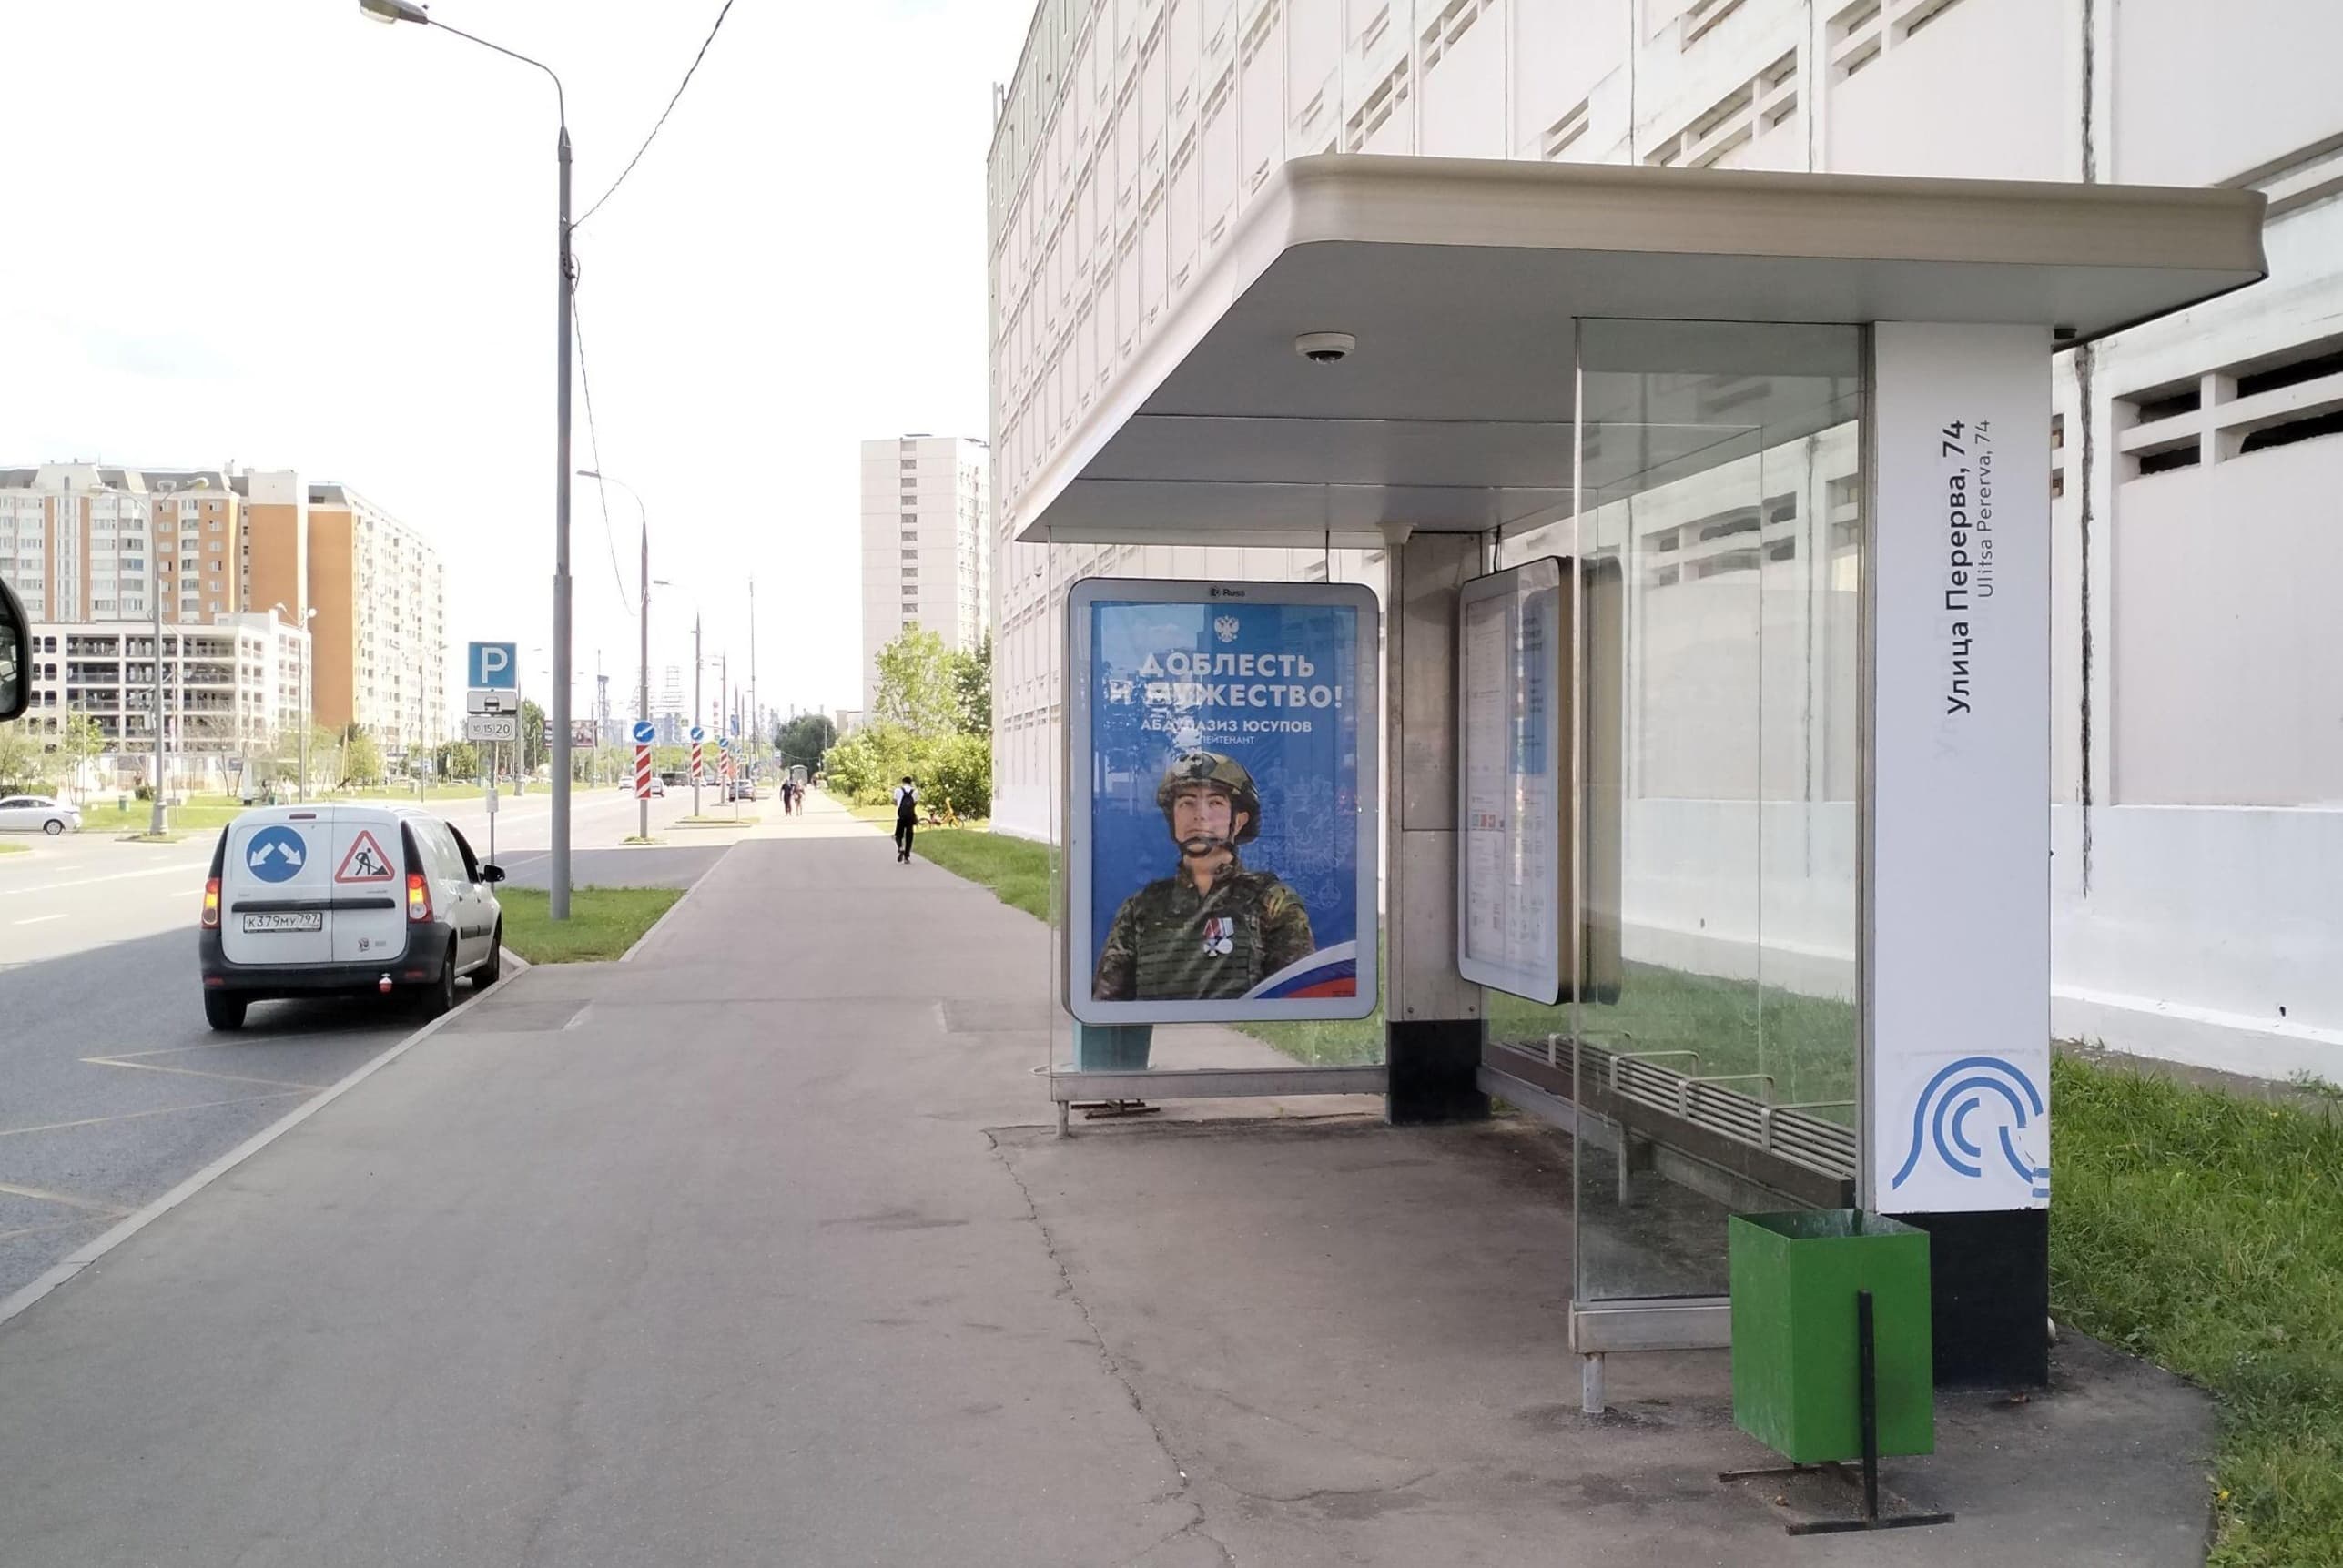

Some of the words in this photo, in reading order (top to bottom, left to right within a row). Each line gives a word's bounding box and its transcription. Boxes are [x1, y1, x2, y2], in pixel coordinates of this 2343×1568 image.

[1942, 420, 1966, 458] 74
[1974, 420, 1991, 445] 74
[1976, 450, 1994, 532] Pererva,
[1944, 467, 1974, 610] Перерва,
[1976, 539, 1993, 598] Ulitsa
[481, 646, 509, 684] P
[1139, 652, 1316, 678] ДОБЛЕСТЬ
[1947, 622, 1973, 715] Улица
[1144, 681, 1343, 709] ЖЕСТВО!
[483, 724, 493, 733] 15
[495, 723, 511, 734] 20
[1140, 718, 1239, 733] АБДАЗИЗ
[1242, 719, 1313, 733] ЮСУПОВ
